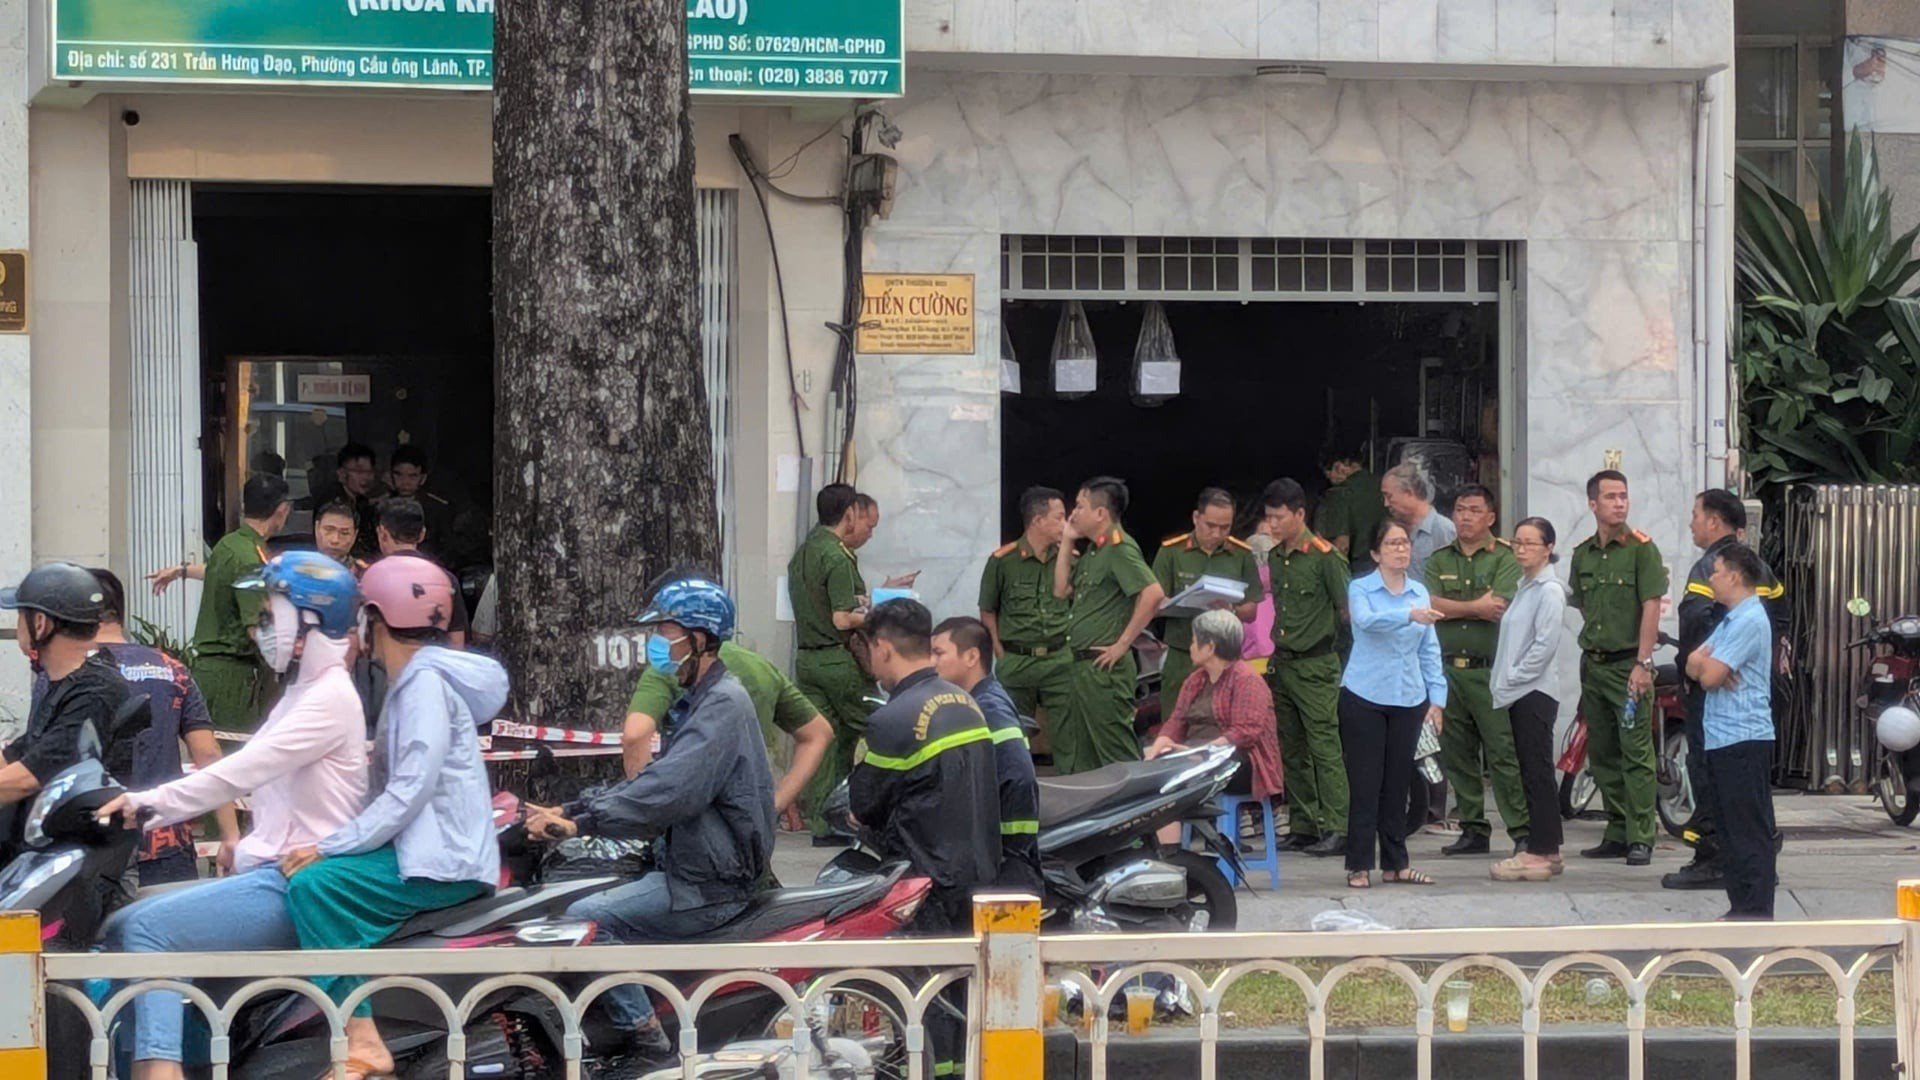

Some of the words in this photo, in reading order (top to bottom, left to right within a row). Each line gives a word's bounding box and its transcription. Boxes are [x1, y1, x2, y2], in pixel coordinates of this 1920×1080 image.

[728, 33, 752, 52] Số:
[755, 36, 886, 54] 07629/HCM-GPHD
[67, 50, 93, 72] Địa
[97, 49, 125, 69] chỉ:
[129, 49, 147, 69] số
[150, 52, 177, 70] 231
[221, 54, 259, 75] Hưng
[263, 55, 297, 76] Đạo,
[301, 55, 355, 78] Phường
[360, 55, 388, 75] Cầu
[466, 59, 490, 77] TP.
[708, 66, 753, 86] thoại:
[758, 67, 800, 87] (028)
[804, 68, 844, 85] 3836
[849, 69, 889, 86] 7077
[864, 287, 904, 315] TIẾN
[908, 290, 968, 316] CƯỜNG
[592, 633, 647, 669] 101
